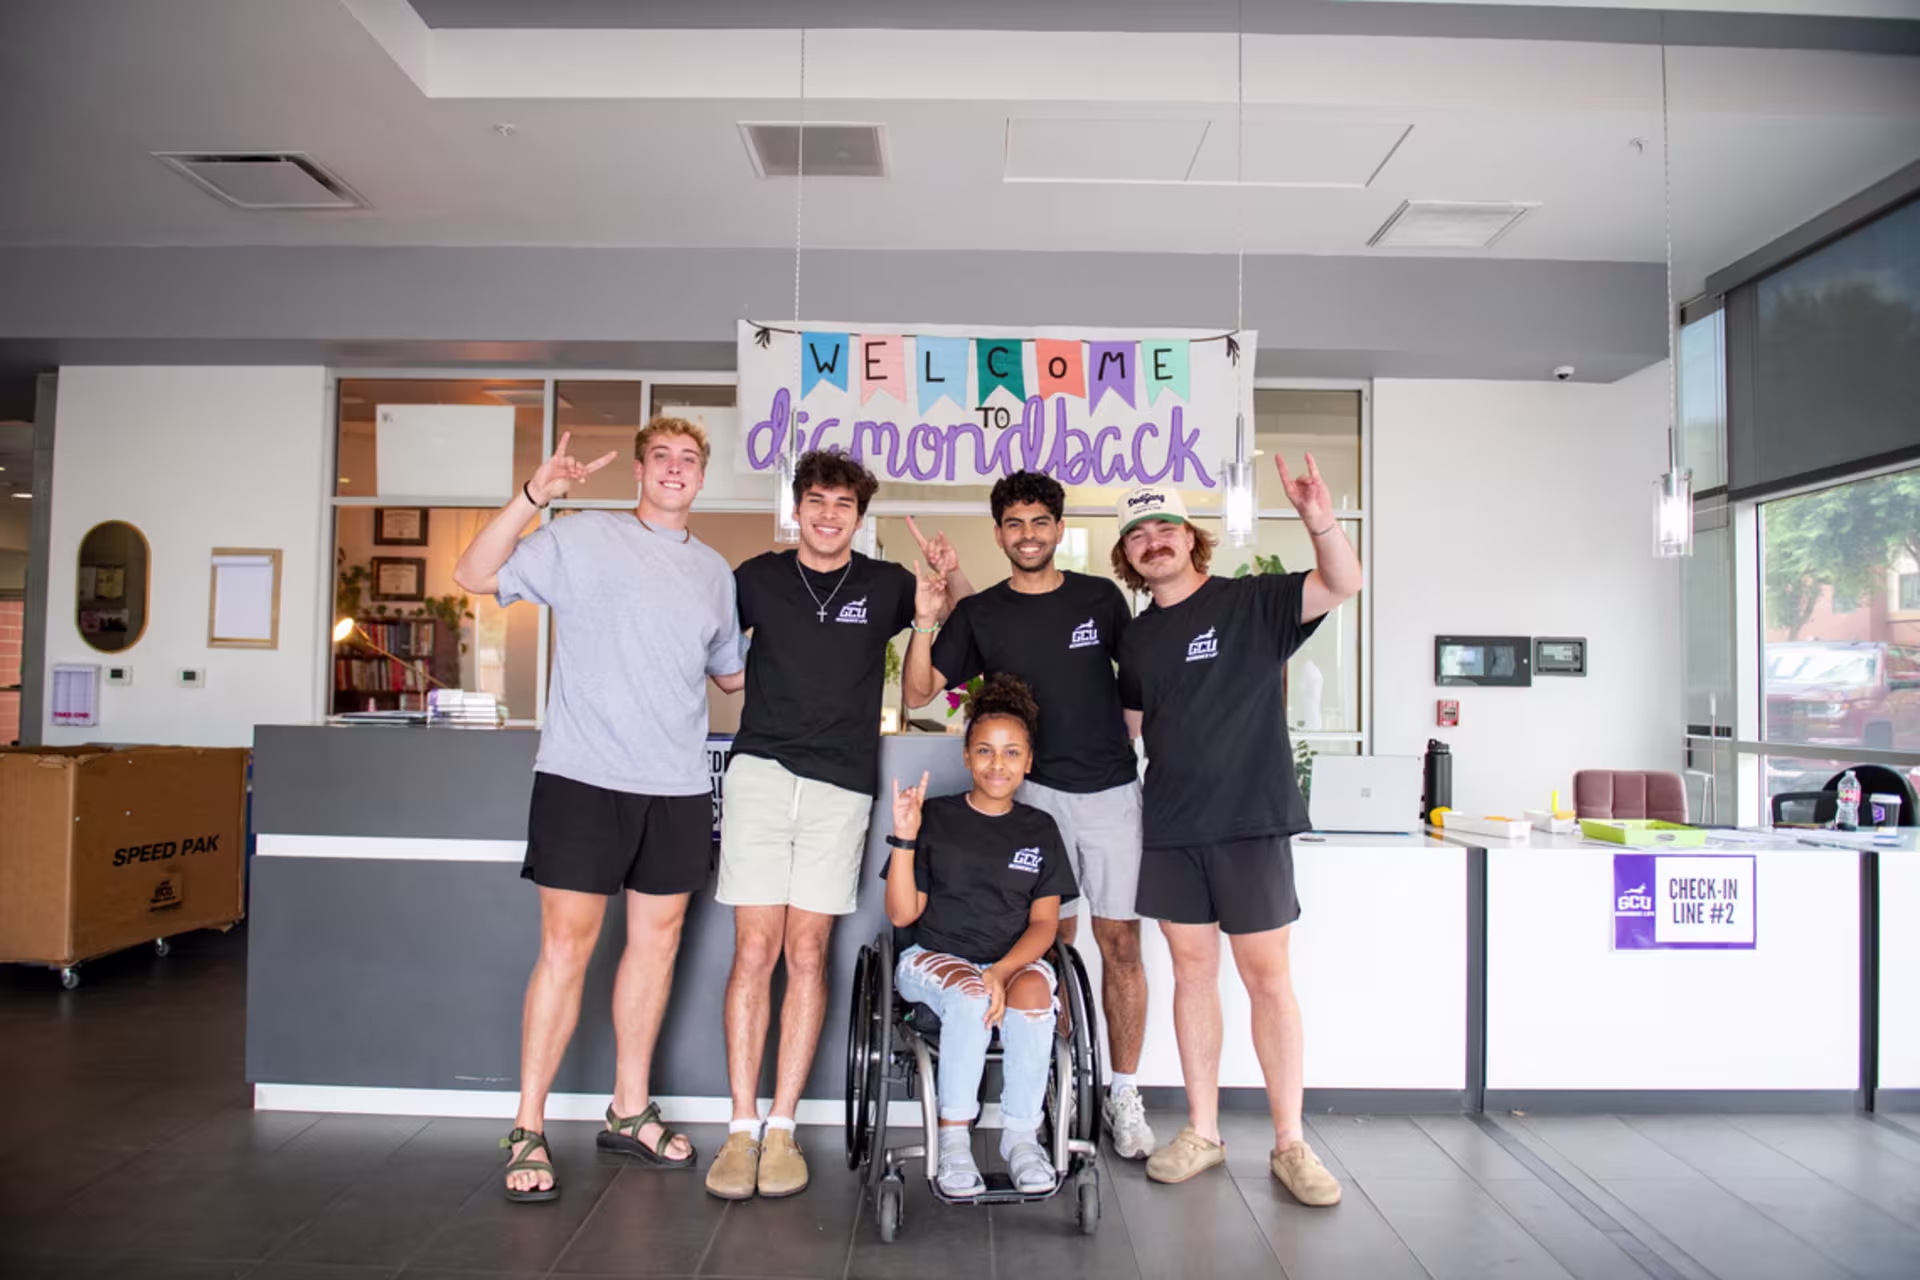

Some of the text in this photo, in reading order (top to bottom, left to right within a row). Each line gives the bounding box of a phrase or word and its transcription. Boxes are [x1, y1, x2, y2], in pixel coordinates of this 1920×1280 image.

[809, 341, 1173, 382] WELCOME
[975, 406, 1011, 428] TO
[839, 605, 867, 618] GCU
[1072, 628, 1098, 643] GCU
[1188, 638, 1218, 656] GCU
[112, 834, 220, 867] SPEED PAK
[1013, 851, 1043, 868] GCU
[1669, 877, 1738, 900] CHECK-IN
[1618, 895, 1652, 910] GCU
[1672, 902, 1735, 924] LINE #2
